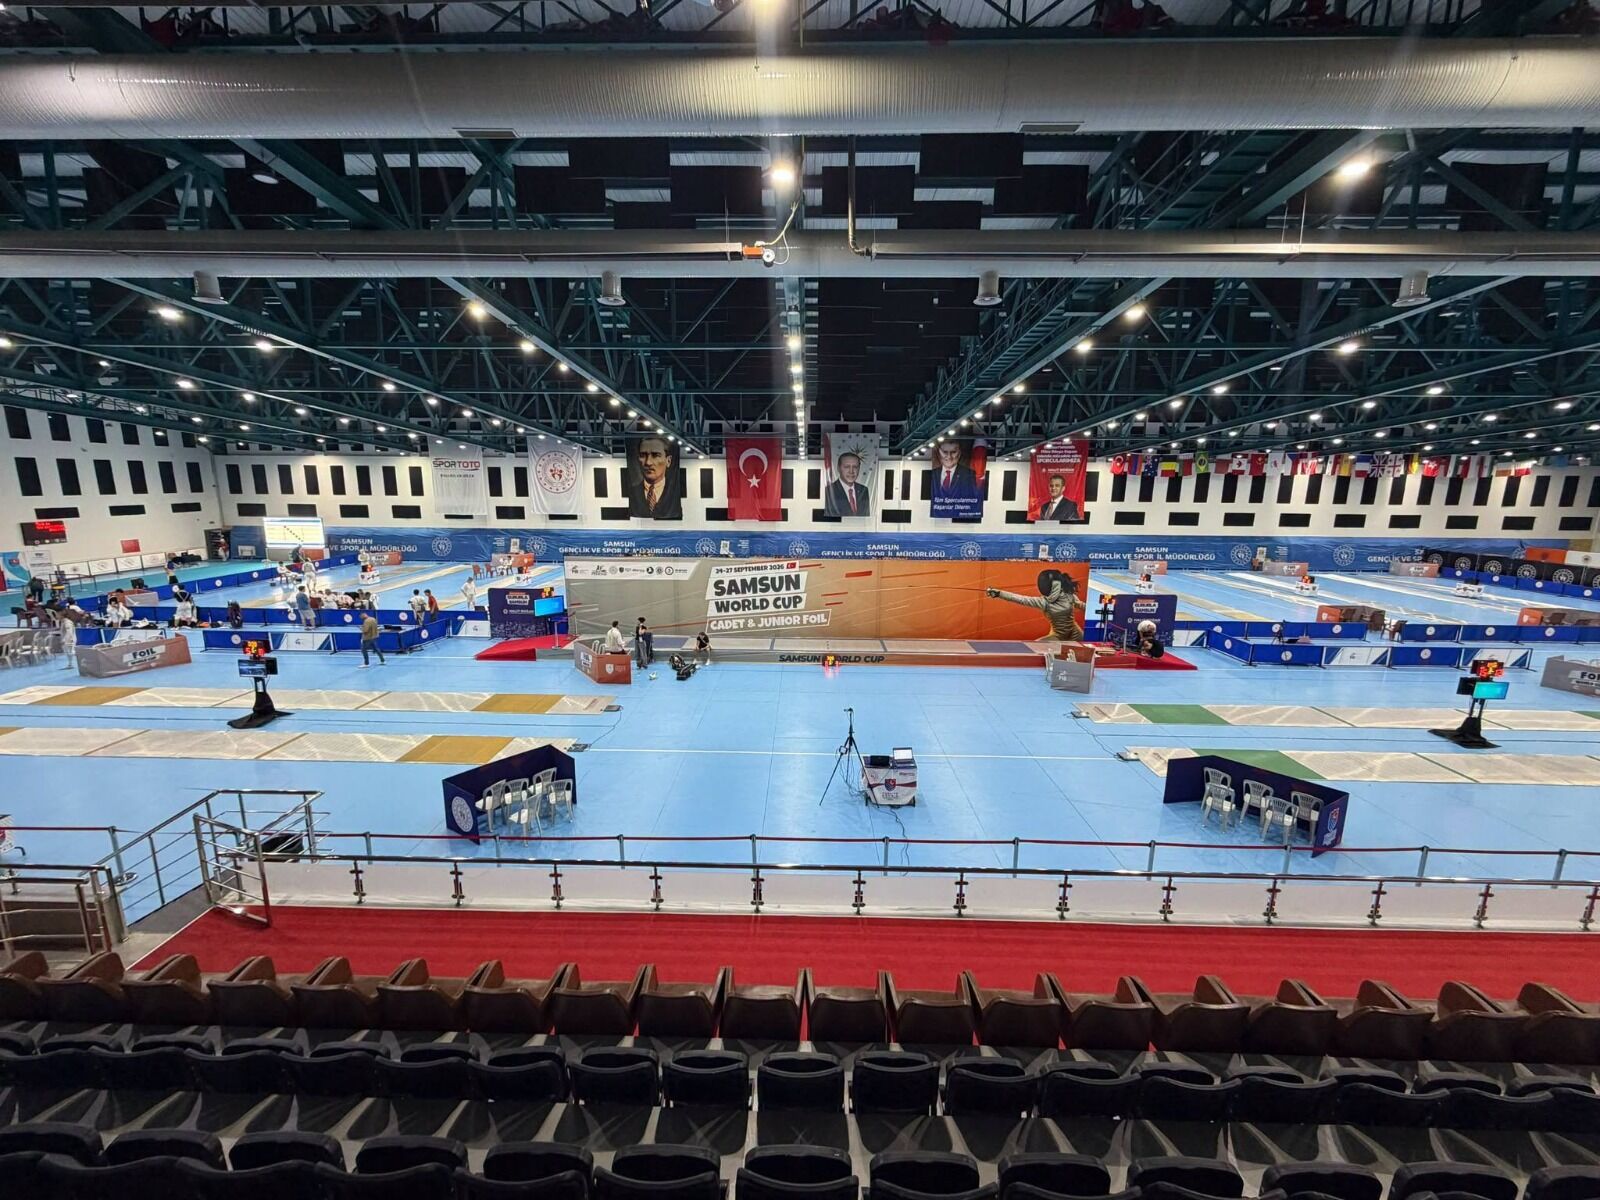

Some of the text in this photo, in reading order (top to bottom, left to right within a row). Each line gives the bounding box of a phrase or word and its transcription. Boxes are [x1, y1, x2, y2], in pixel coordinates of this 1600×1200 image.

[370, 544, 417, 552] MÜDÜRLÜĞÜ
[559, 547, 590, 555] GENÇLİK
[1368, 554, 1399, 563] GENÇLİK
[734, 565, 768, 573] SEPTEMBER
[714, 574, 800, 596] SAMSUN
[715, 596, 802, 613] WORLD CUP
[710, 613, 827, 630] CADET & JUNIOR FOIL
[132, 648, 156, 658] FOIL
